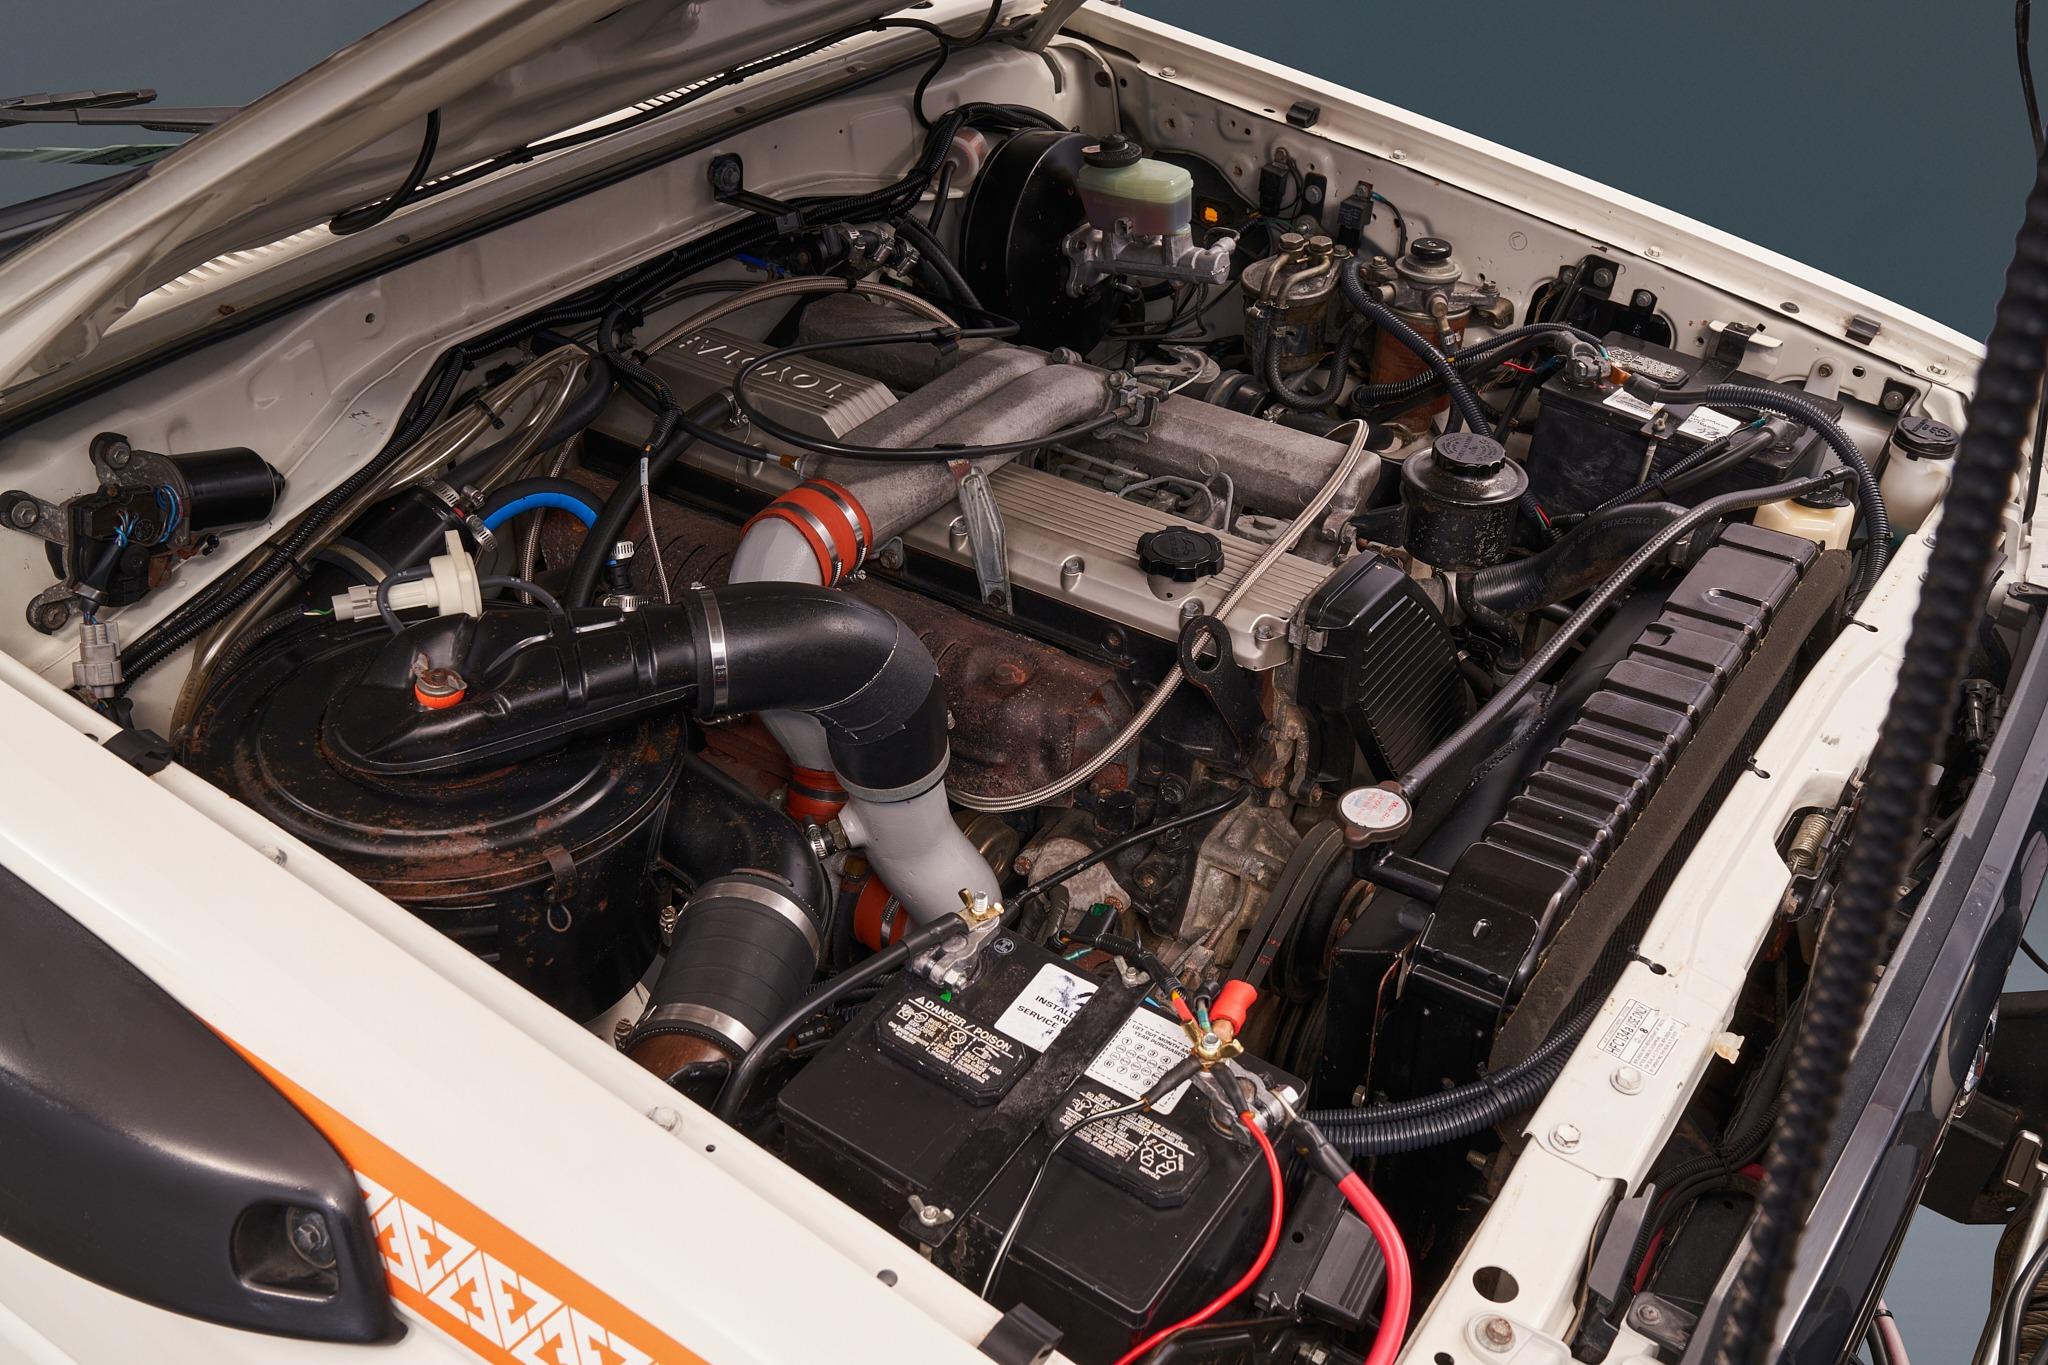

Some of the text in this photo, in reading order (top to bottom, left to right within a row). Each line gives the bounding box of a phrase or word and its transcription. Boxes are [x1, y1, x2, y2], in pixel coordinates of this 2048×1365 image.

[924, 1001, 966, 1027] DANGER
[973, 1028, 1012, 1052] POISON
[1017, 1005, 1059, 1028] SERVICE
[1132, 1024, 1144, 1032] LIFT
[1145, 1030, 1157, 1038] OUT
[1157, 1036, 1180, 1050] MONTH
[1134, 1031, 1150, 1041] YEAR
[1150, 1038, 1187, 1059] PURCHASED
[1606, 1026, 1635, 1056] HFC134a
